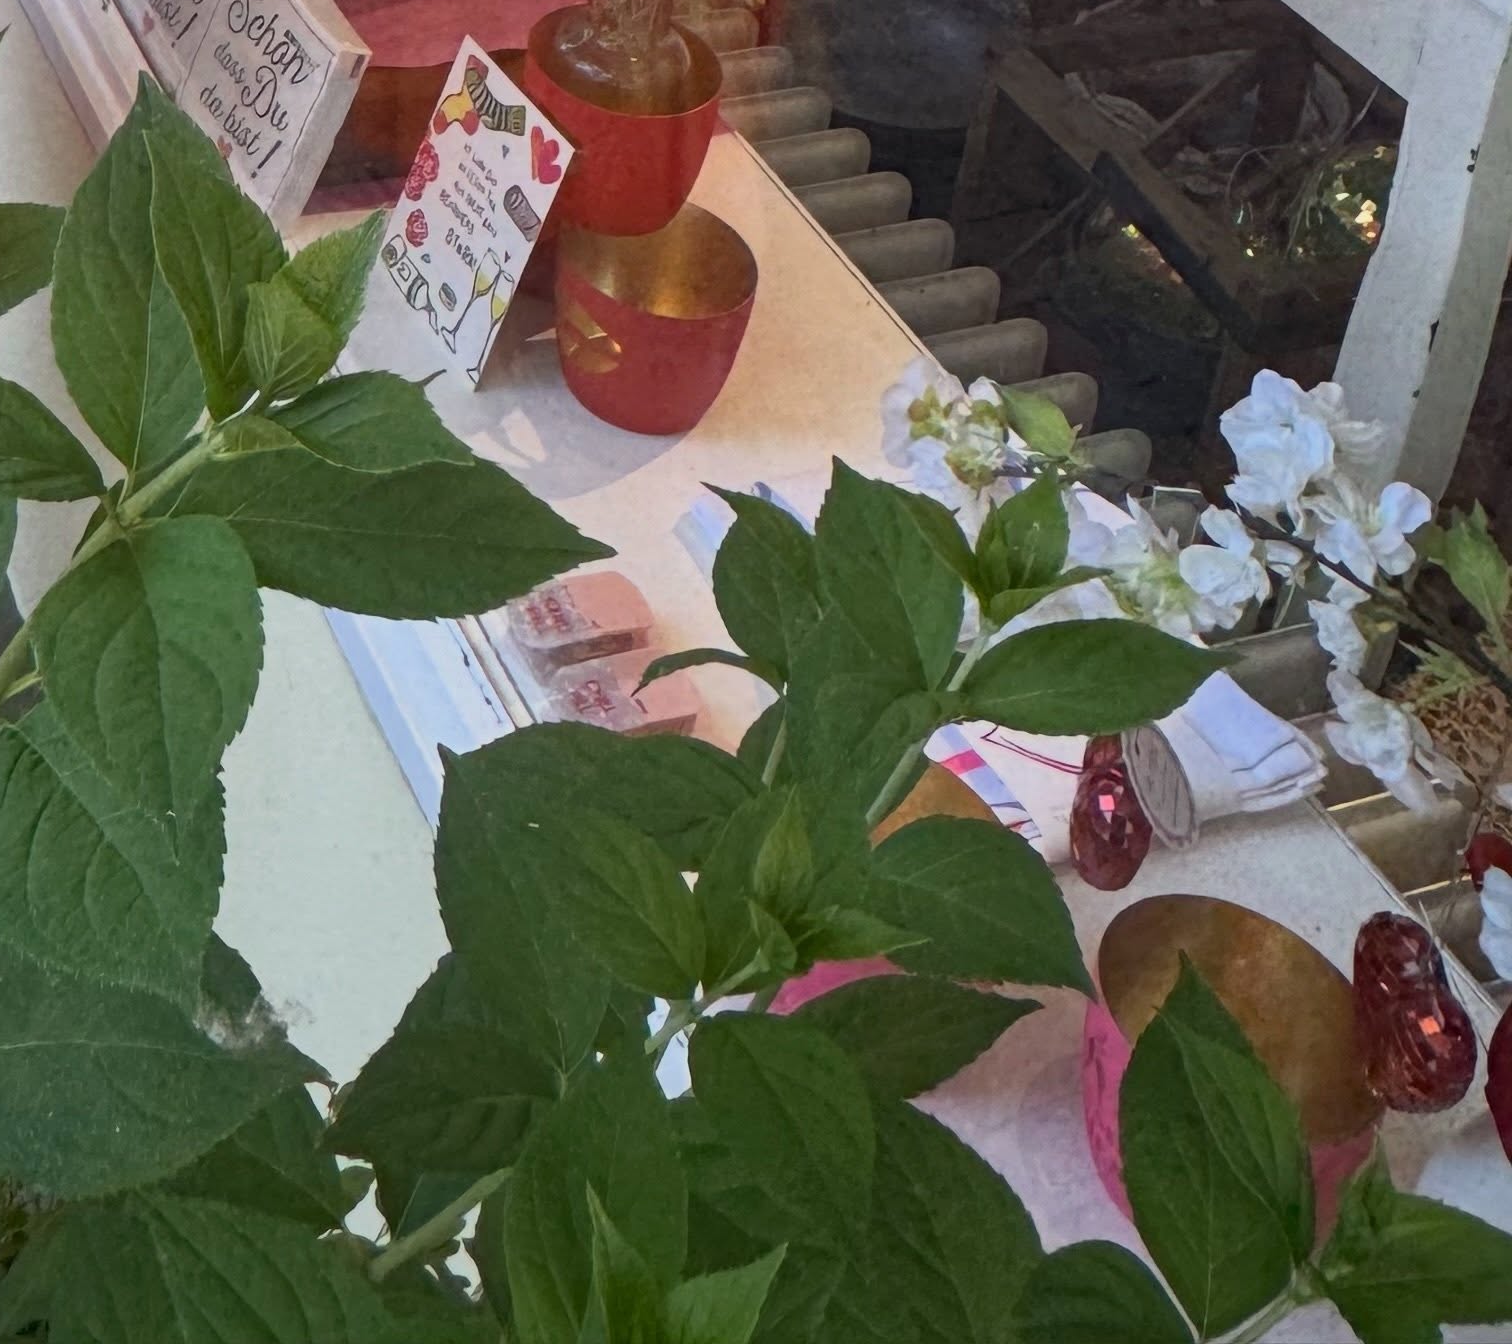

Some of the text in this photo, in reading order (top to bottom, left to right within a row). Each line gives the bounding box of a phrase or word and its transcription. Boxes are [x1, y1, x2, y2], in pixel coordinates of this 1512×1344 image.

[199, 83, 224, 122] da
[213, 40, 289, 132] dass Du
